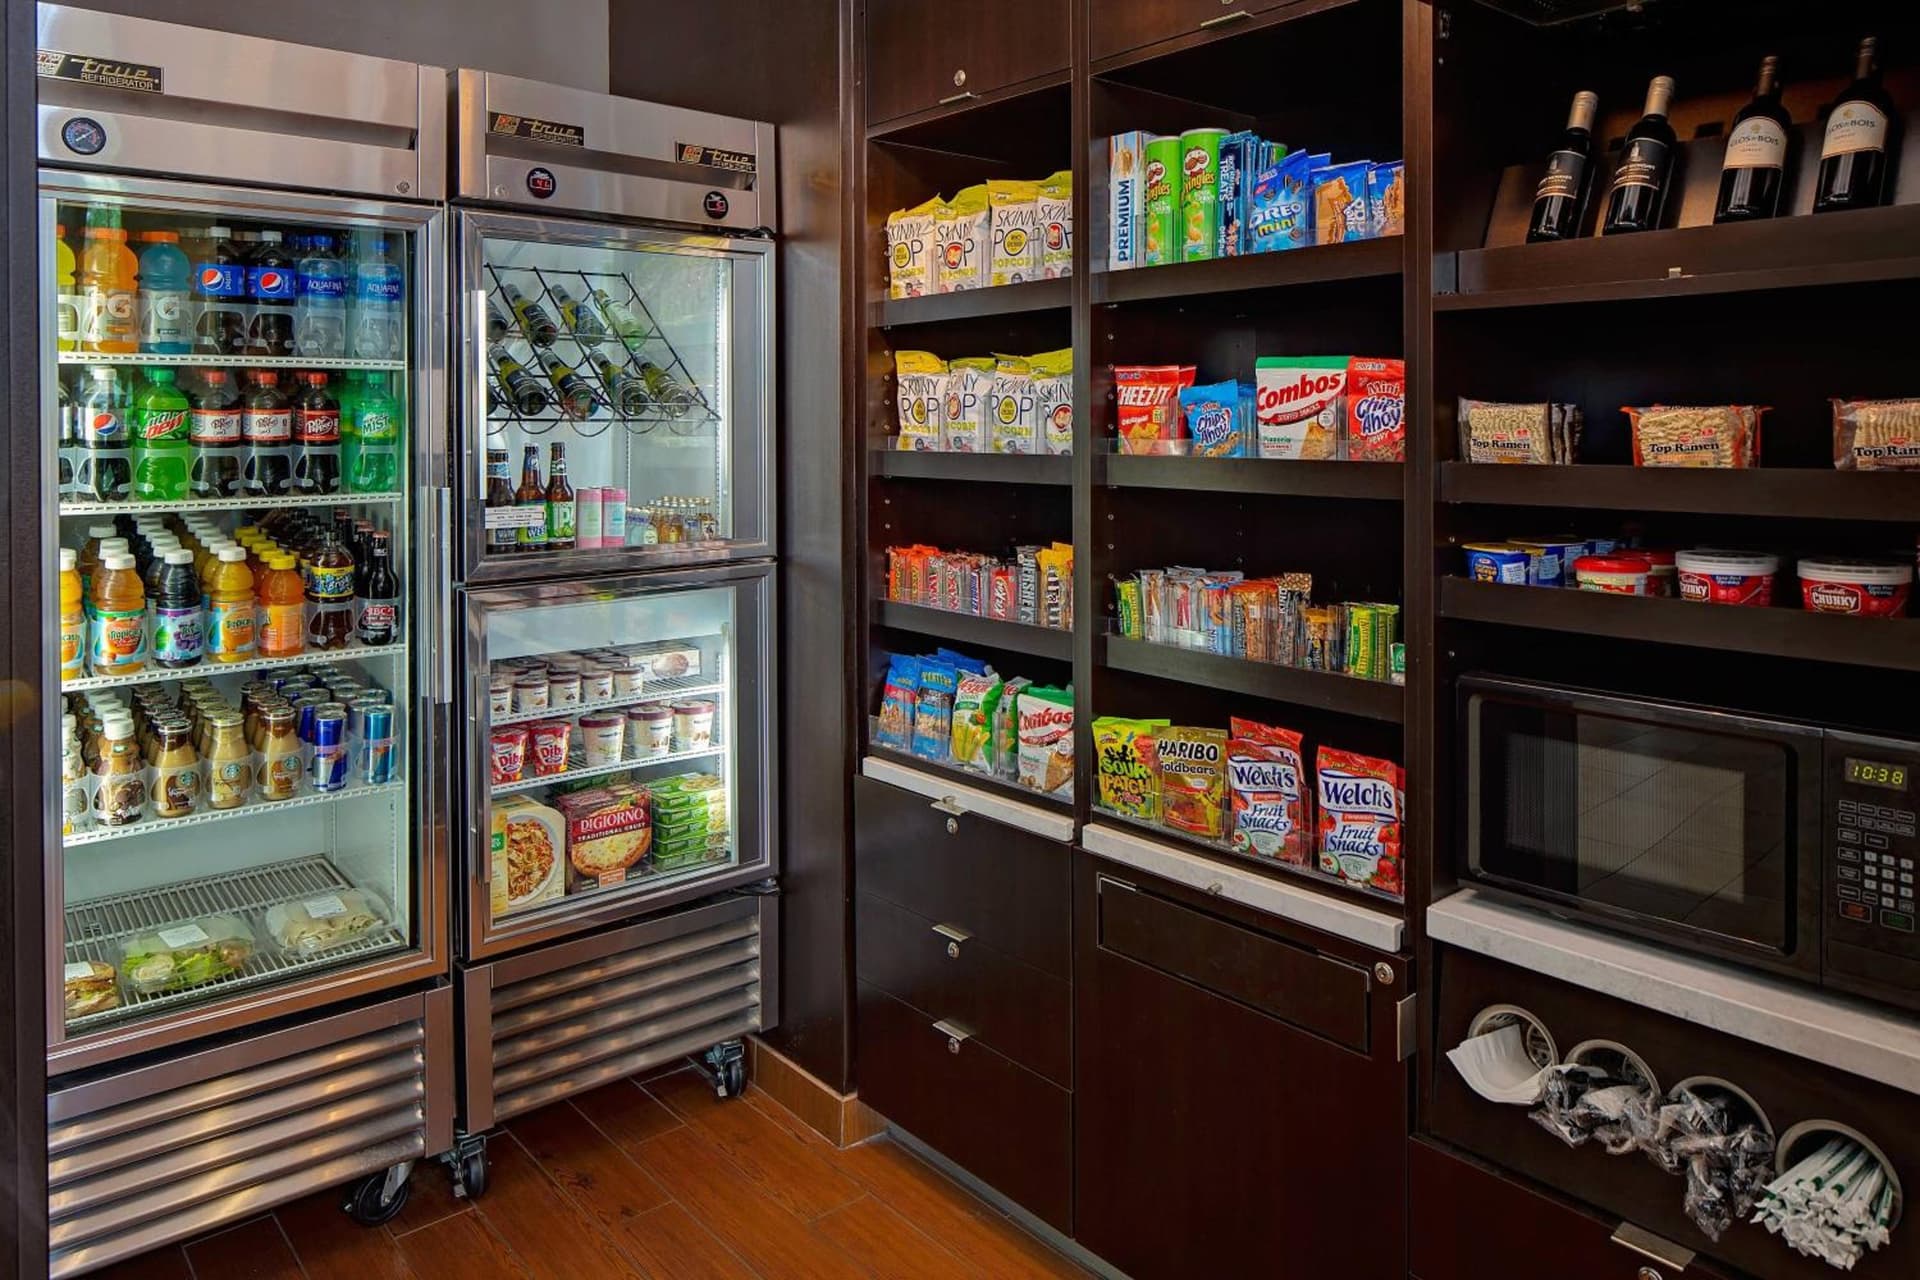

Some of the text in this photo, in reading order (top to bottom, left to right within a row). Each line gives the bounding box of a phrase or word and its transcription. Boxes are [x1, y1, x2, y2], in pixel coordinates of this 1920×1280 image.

[80, 72, 153, 91] REFRIGERATOR
[1850, 118, 1876, 129] BOIS
[1758, 135, 1779, 146] BOIS
[1219, 158, 1229, 203] TREATS
[996, 207, 1038, 227] SKINN
[1117, 179, 1130, 262] PREMIUM
[1249, 203, 1302, 229] OREO
[1258, 215, 1297, 238] mini
[308, 279, 343, 291] AQUAFINA
[1257, 373, 1342, 411] Combos
[1367, 380, 1400, 396] Mini
[901, 397, 940, 424] POP
[1357, 395, 1403, 419] Chips
[1472, 438, 1531, 450] Top Ramen
[1649, 441, 1720, 453] Top Ramen
[1853, 446, 1882, 458] Top
[1812, 591, 1857, 609] CHUNKY
[497, 752, 520, 768] Dib
[1158, 740, 1218, 762] HARIBO
[1102, 758, 1148, 779] SOUR
[1234, 766, 1295, 788] Welch's
[1854, 765, 1904, 785] 10:38
[1321, 780, 1393, 809] Welch's
[580, 807, 645, 833] DIGIORNO
[1251, 803, 1285, 818] Fruit
[577, 822, 646, 842] TRADITIONAL CRUST
[1239, 813, 1290, 832] Snacks
[1339, 824, 1376, 840] Fruit
[1328, 835, 1380, 857] Snacks
